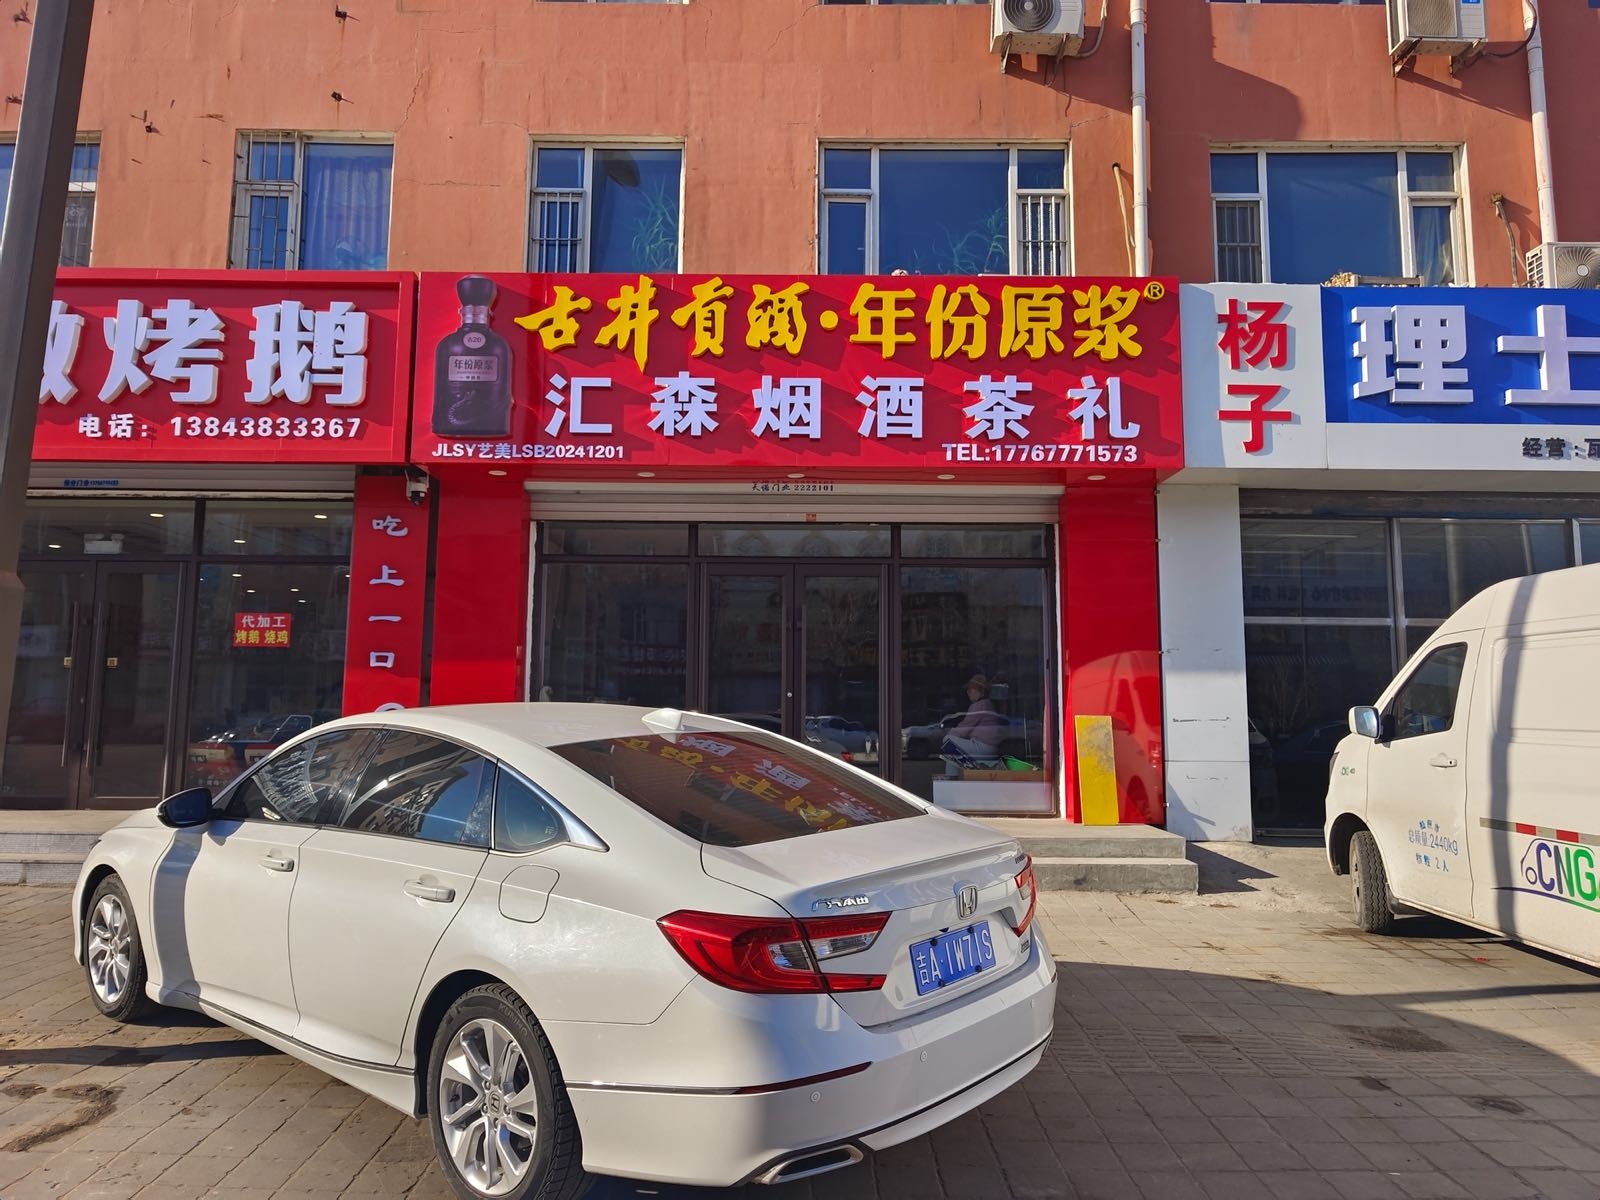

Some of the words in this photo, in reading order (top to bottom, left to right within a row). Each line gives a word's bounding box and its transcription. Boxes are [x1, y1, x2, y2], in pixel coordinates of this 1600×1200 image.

[544, 371, 1140, 438] 汇森烟酒茶礼
[1217, 299, 1292, 453] 杨子
[432, 443, 624, 460] JLSY艺美LSB20241201
[242, 615, 286, 628] 代加工
[1536, 842, 1597, 901] CNG
